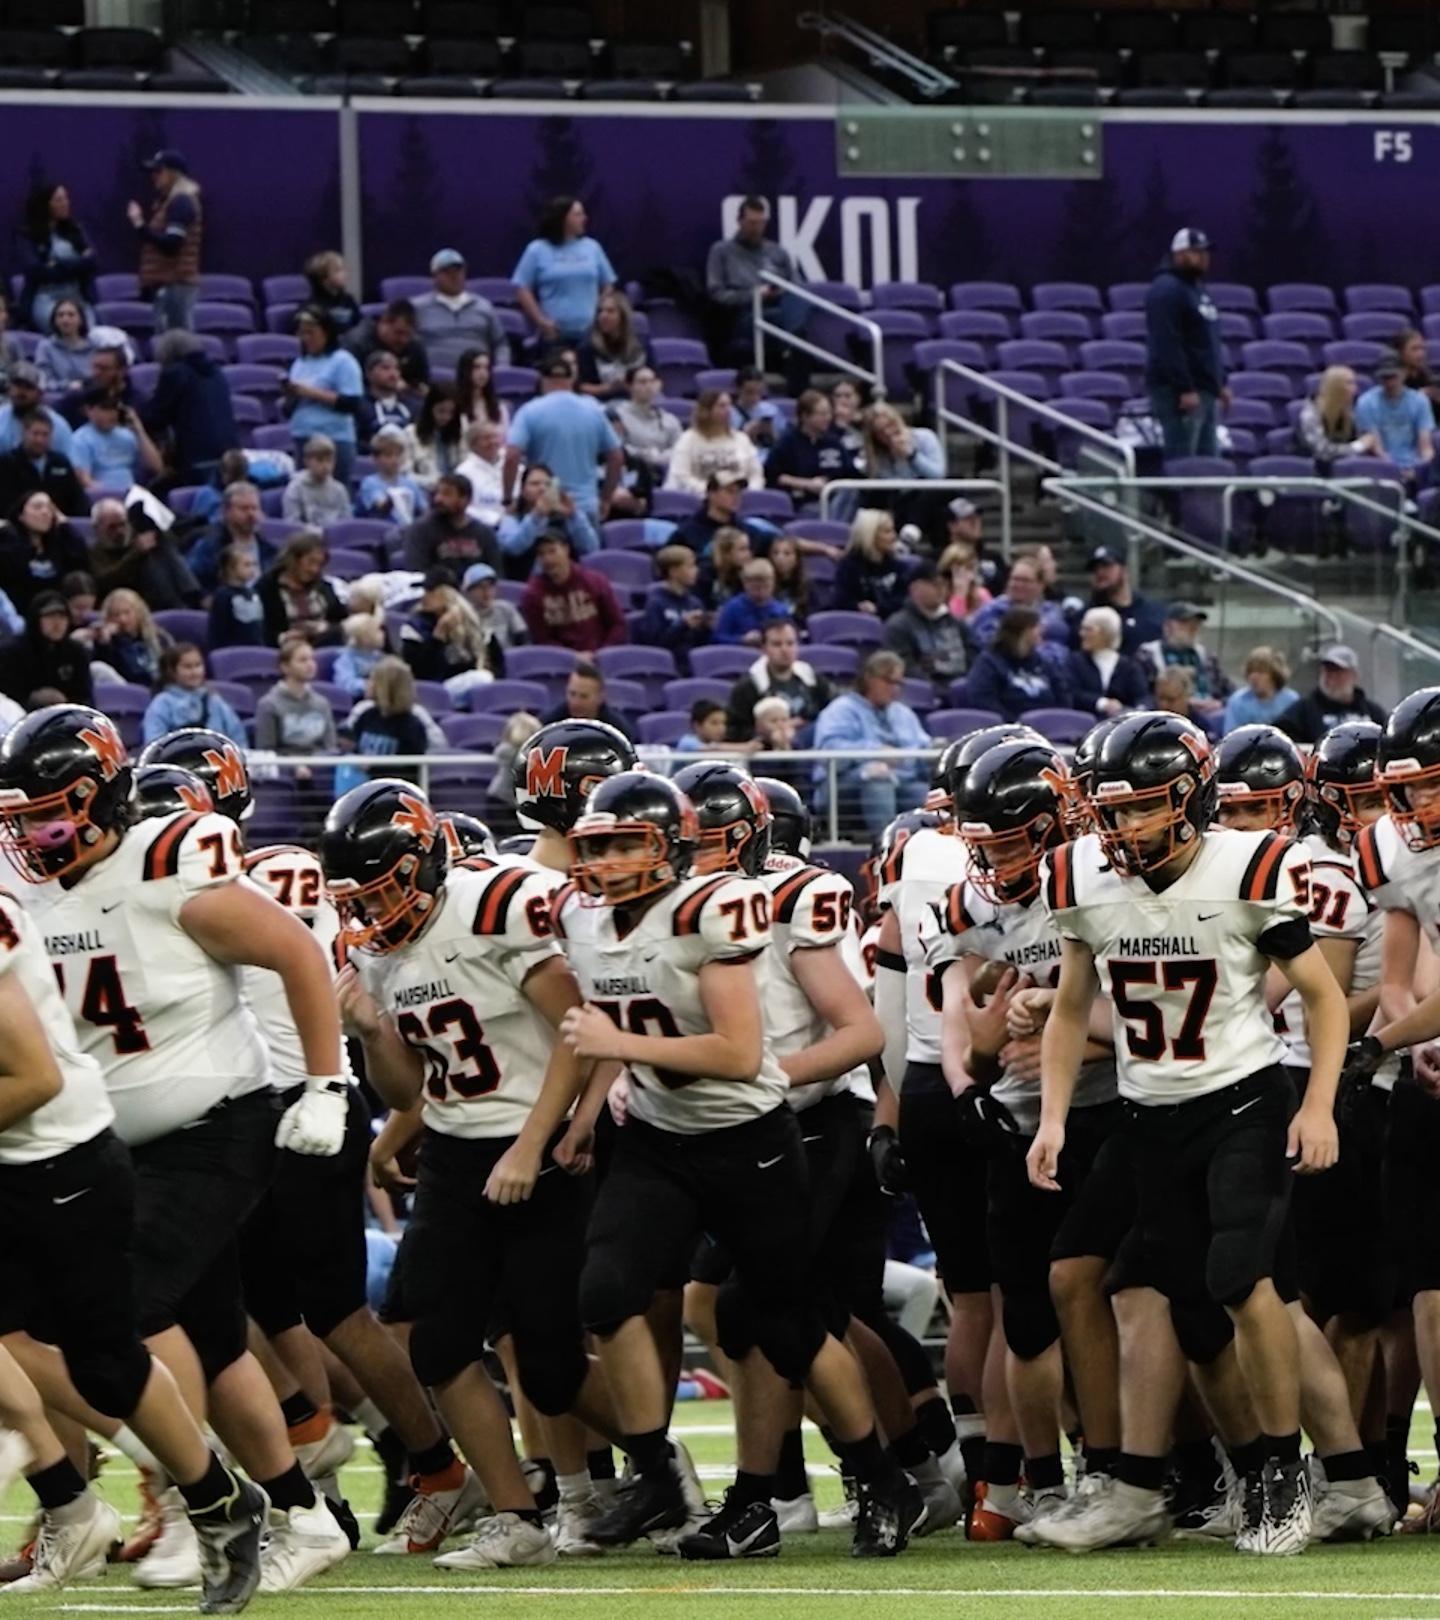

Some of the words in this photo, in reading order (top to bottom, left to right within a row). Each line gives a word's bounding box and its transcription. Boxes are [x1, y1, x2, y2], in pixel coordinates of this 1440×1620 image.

[721, 195, 923, 306] KOL
[76, 716, 129, 782] M
[202, 744, 248, 799] M
[527, 746, 569, 799] M
[390, 791, 438, 853] M
[267, 868, 320, 907] 72
[1287, 859, 1313, 907] 5
[525, 888, 558, 938] 6
[718, 891, 770, 942] 70
[1119, 936, 1200, 957] MARSHALL
[52, 954, 153, 1055] 4
[394, 978, 455, 1009] MARSHALL
[592, 976, 651, 996] MARSHALL
[1107, 958, 1218, 1062] 57
[398, 998, 502, 1101] 63
